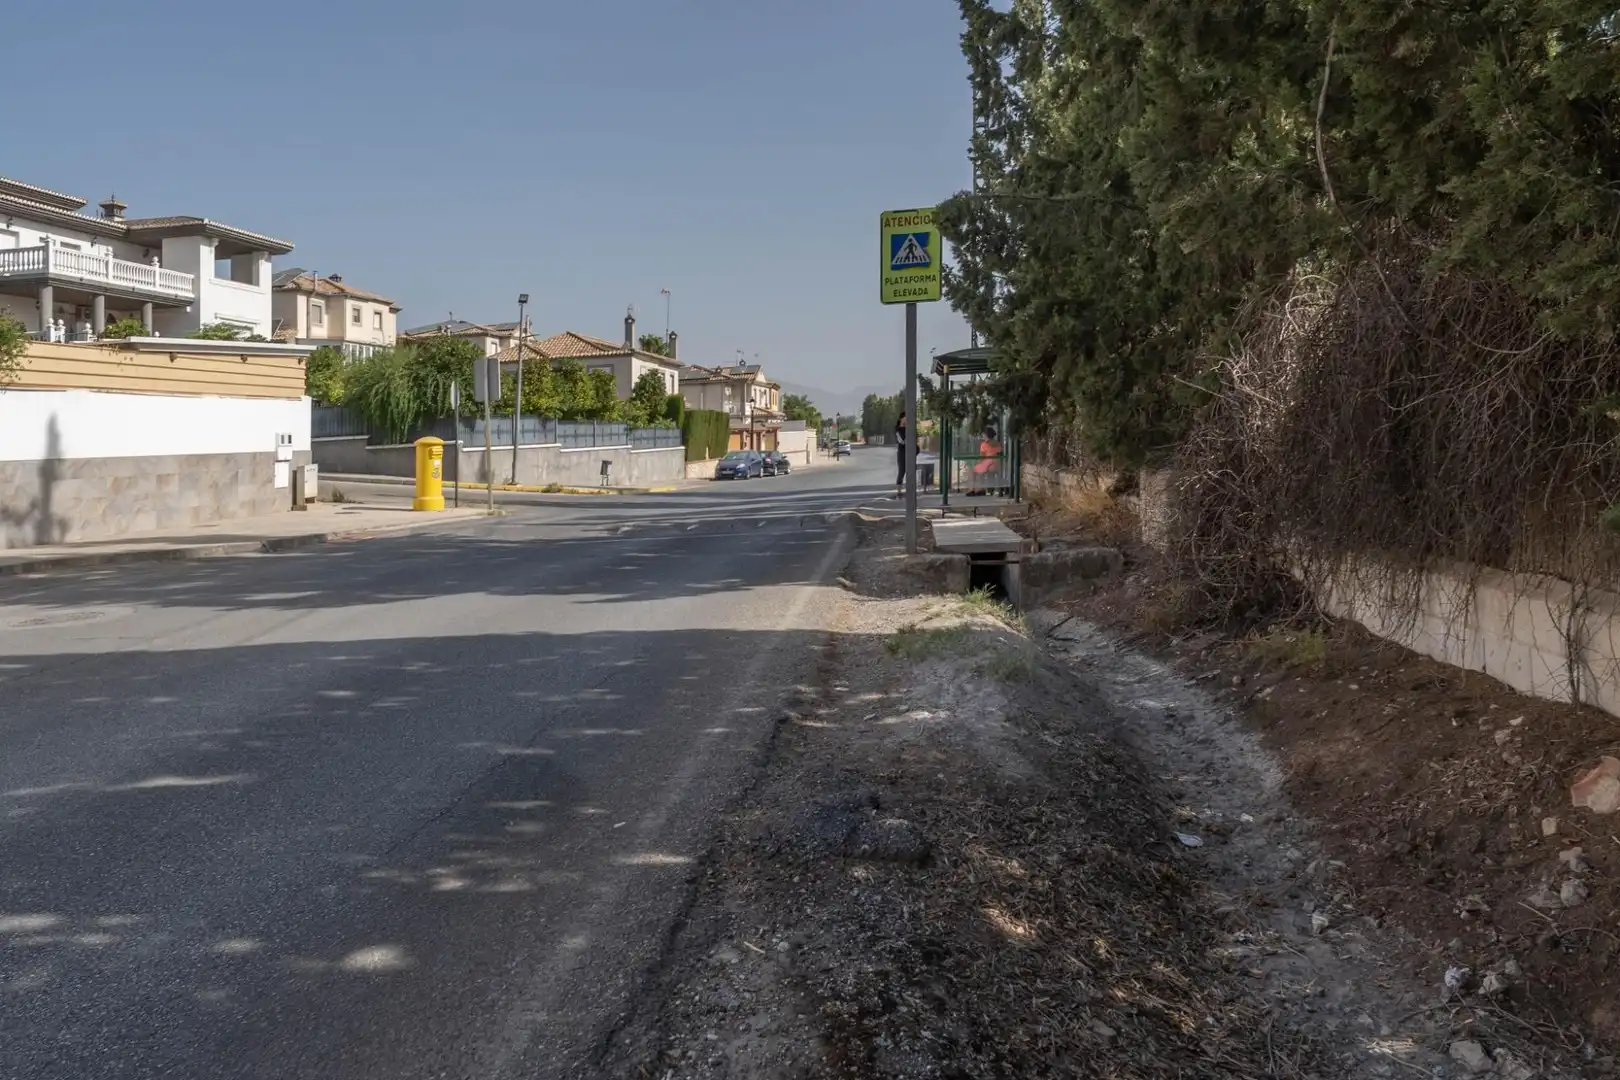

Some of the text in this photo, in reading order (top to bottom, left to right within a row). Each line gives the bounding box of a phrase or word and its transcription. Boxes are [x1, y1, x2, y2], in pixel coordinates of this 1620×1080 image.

[884, 215, 936, 228] ATENCIO
[884, 274, 937, 286] PLATAFORMA
[893, 287, 929, 298] ELEVADA
